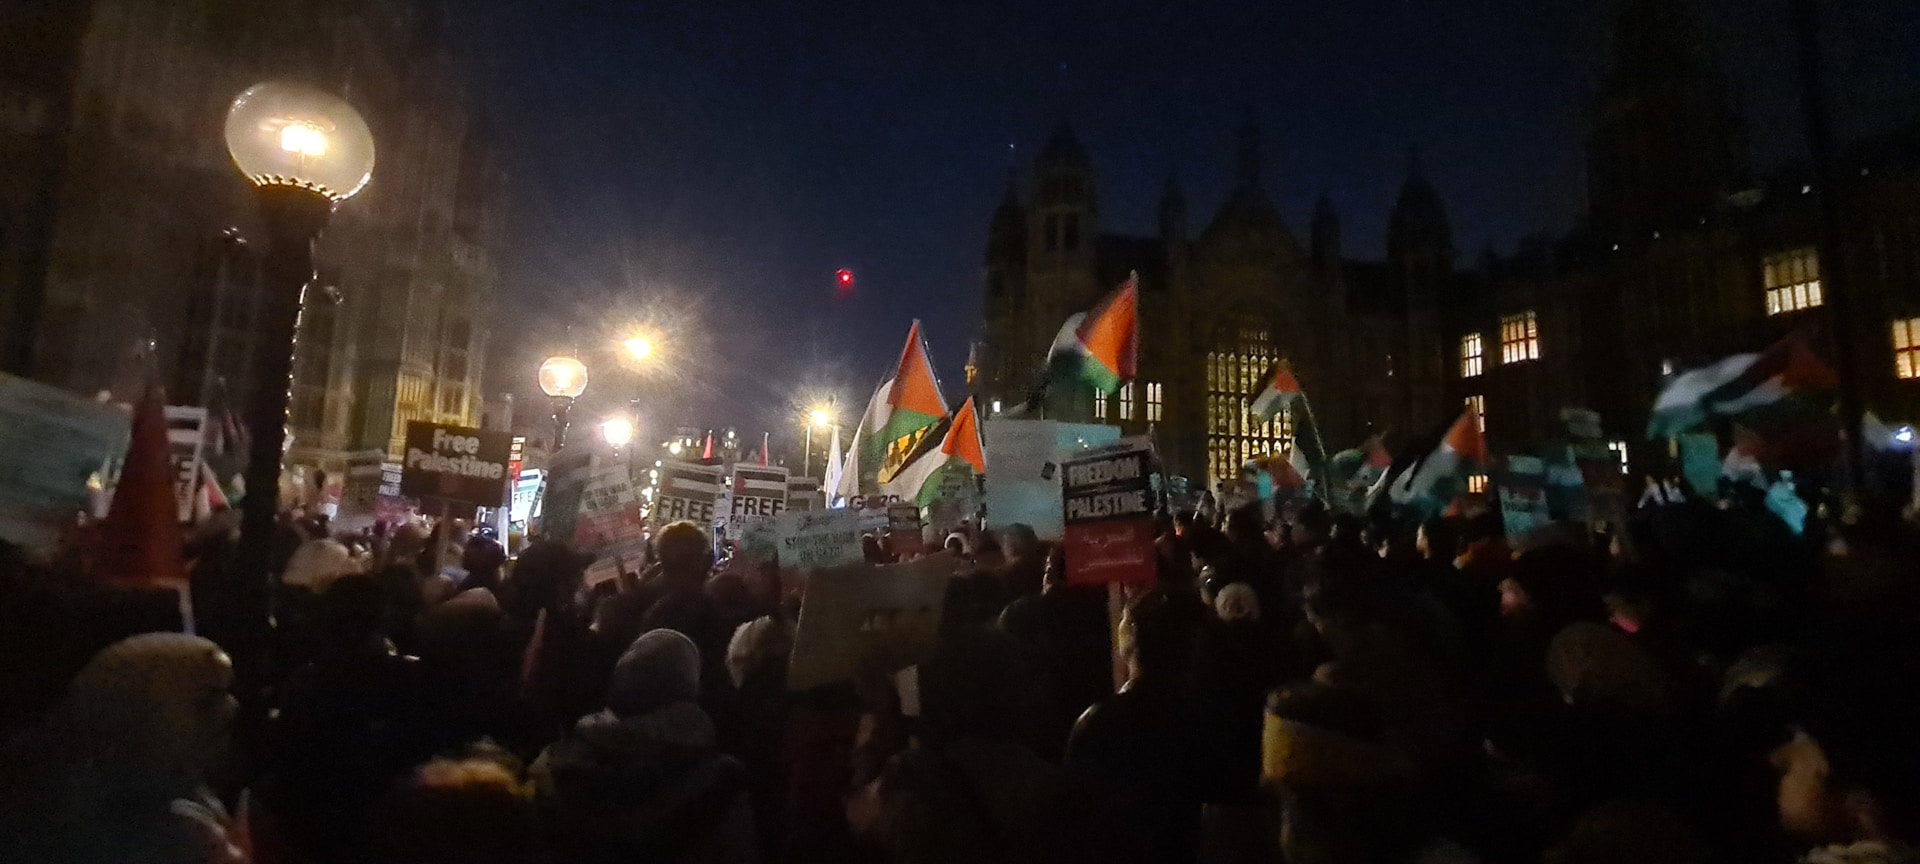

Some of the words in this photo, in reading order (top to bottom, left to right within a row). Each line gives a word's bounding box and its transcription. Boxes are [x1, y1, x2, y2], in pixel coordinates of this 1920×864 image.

[433, 428, 480, 454] Free
[407, 448, 504, 479] Palestine
[1067, 455, 1141, 487] FREEDOM
[656, 496, 714, 522] FREE
[1066, 489, 1148, 520] PALESTINE
